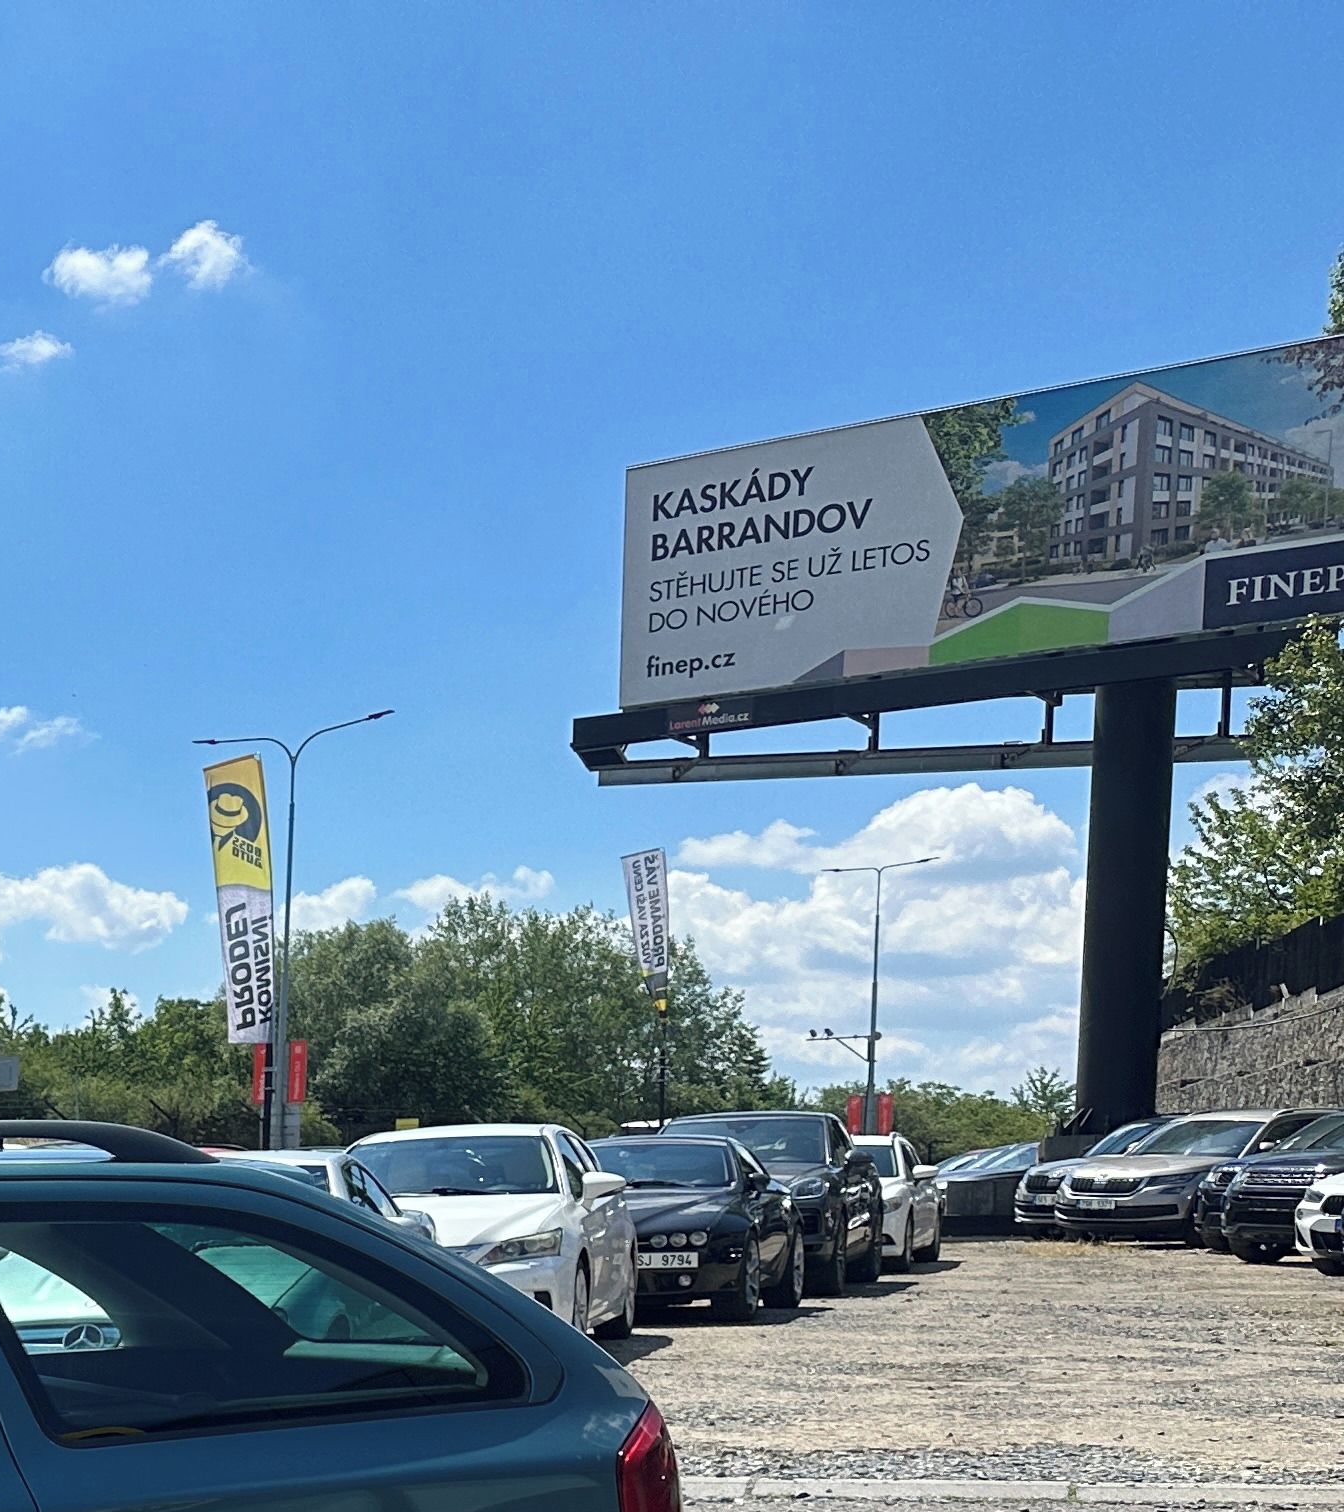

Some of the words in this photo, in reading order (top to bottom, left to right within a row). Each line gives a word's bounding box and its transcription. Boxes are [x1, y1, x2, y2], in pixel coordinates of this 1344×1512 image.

[652, 466, 815, 522] KASKÁDY
[651, 498, 873, 561] BARRANDOV
[648, 565, 763, 602] STĚHUJTE
[771, 559, 799, 583] SE
[808, 547, 842, 578] UŽ
[851, 539, 930, 572] LETOS
[1226, 564, 1344, 606] FINEP
[648, 609, 688, 633] DO
[696, 589, 815, 626] NOVÉHO
[646, 652, 736, 678] finep.cz
[637, 1254, 652, 1266] SJ
[661, 1254, 692, 1266] 9794
